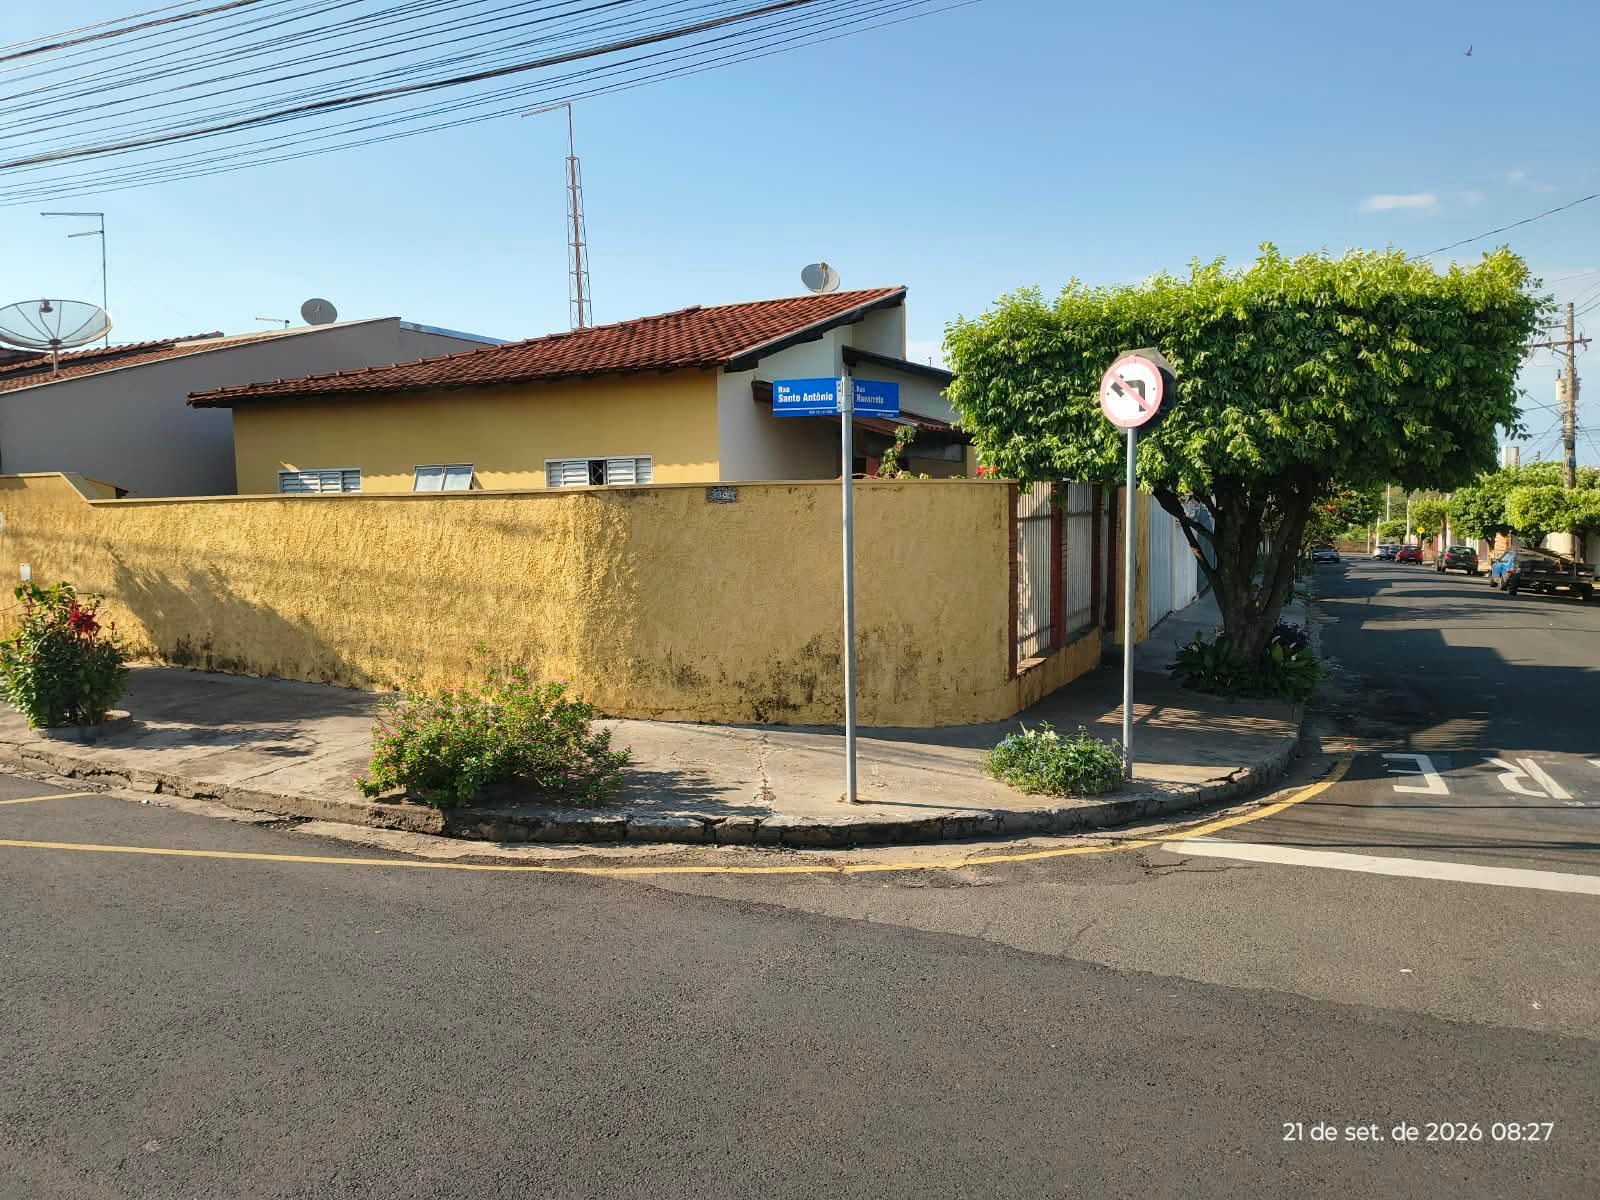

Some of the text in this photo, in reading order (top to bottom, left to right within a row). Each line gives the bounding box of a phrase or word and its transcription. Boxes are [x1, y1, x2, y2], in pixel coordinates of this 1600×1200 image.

[778, 391, 833, 403] Santo Antônio
[1381, 753, 1600, 800] RE
